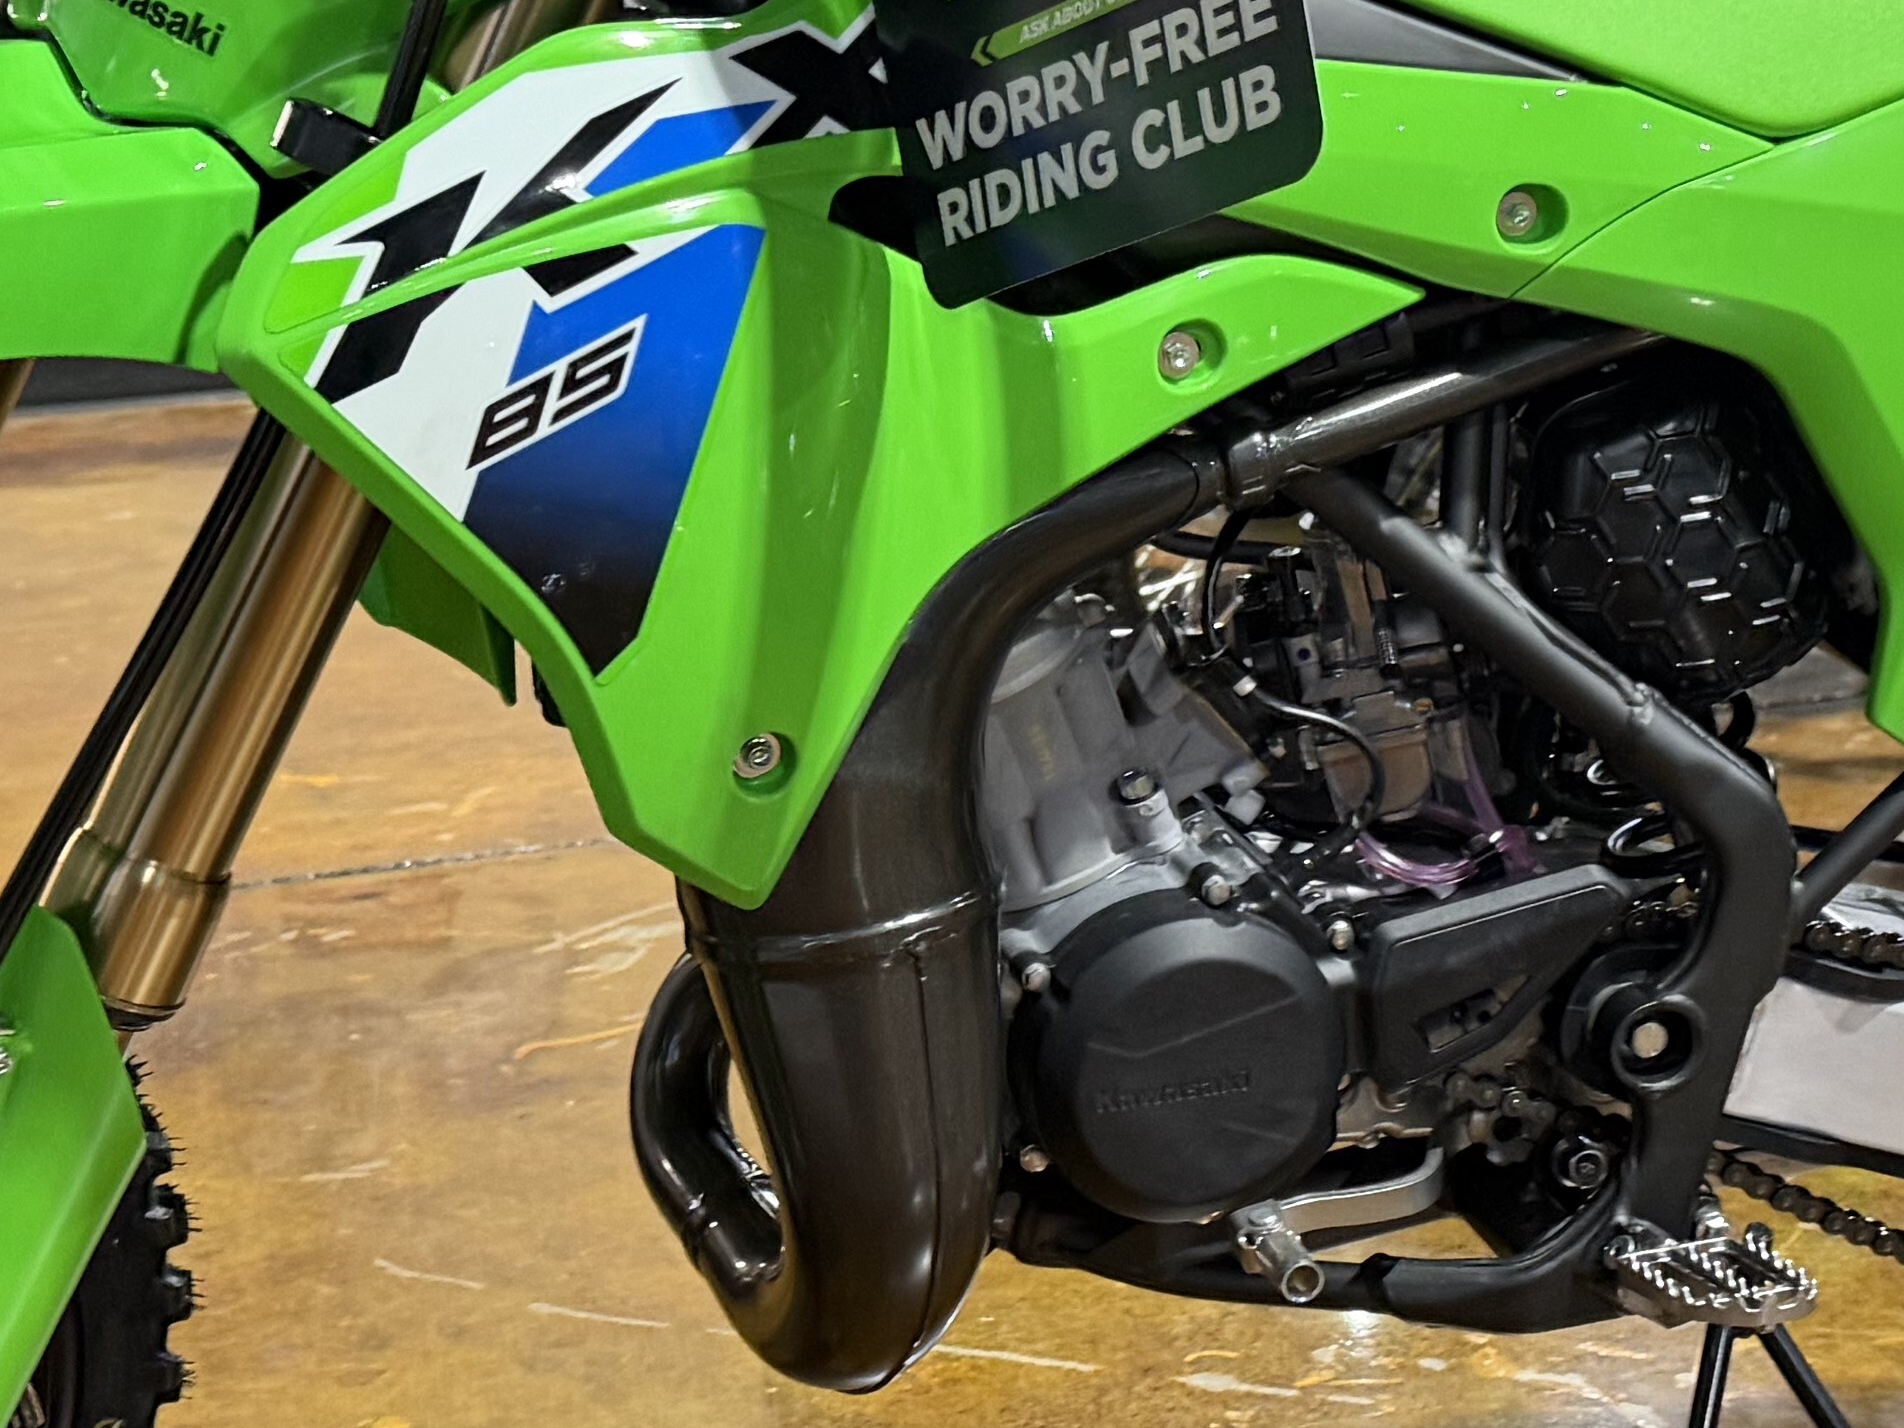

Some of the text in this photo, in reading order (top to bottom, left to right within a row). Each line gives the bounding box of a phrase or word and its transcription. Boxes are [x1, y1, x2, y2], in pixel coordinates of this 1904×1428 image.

[1018, 15, 1050, 44] ASK
[936, 63, 1284, 248] RIDING CLUB
[465, 326, 636, 472] 85
